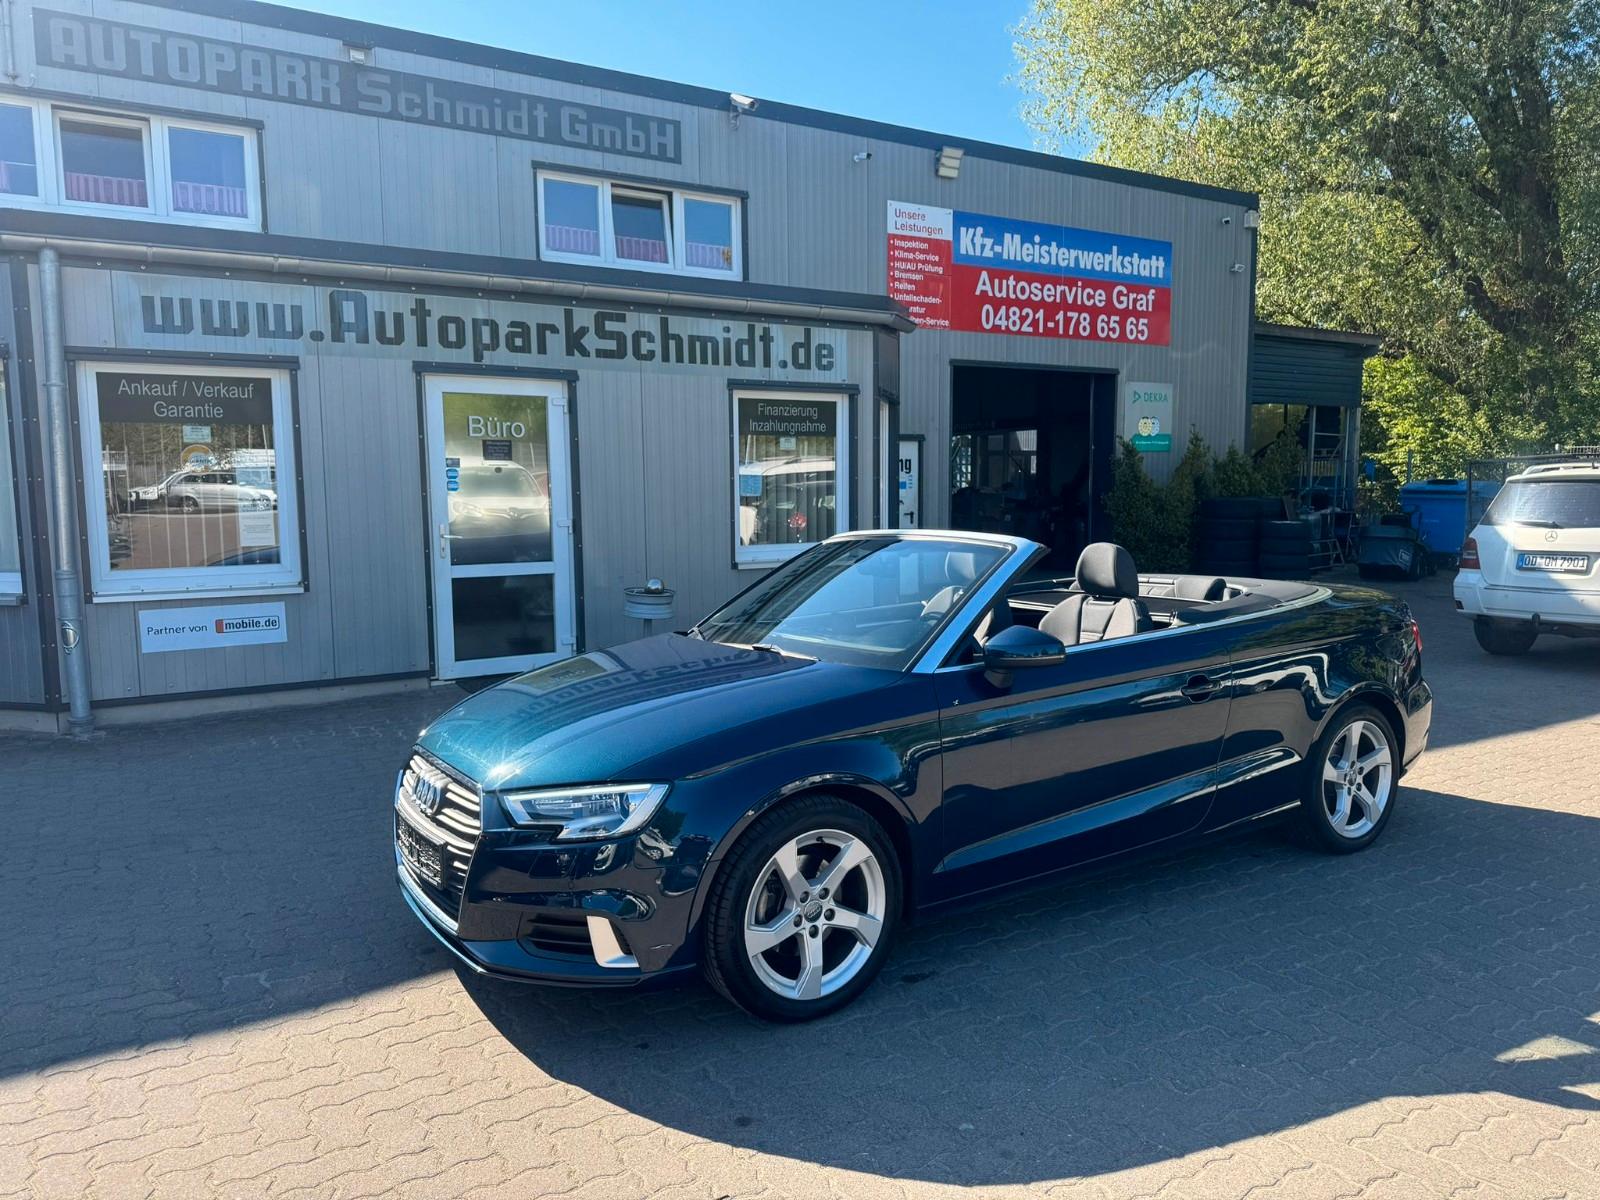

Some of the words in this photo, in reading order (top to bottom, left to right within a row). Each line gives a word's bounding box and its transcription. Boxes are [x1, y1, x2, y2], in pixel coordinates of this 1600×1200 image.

[49, 17, 342, 105] AUTOPARK
[356, 71, 549, 138] Schmidt
[560, 105, 676, 159] GmbH
[894, 207, 926, 221] Unsere
[894, 219, 944, 236] Leistungen
[894, 238, 929, 250] Inspektion
[894, 249, 940, 262] Klima-Service
[959, 226, 1166, 279] Kfz-Meisterwerkstatt
[894, 261, 917, 271] HU/AU
[917, 263, 944, 275] Prüfung
[894, 270, 924, 281] Bremsen
[894, 281, 916, 291] Reifen
[975, 270, 1107, 308] Autoservice
[1112, 285, 1157, 313] Graf
[141, 289, 834, 372] www.AutoparkSchmidt.de
[981, 304, 1091, 337] 04821-178
[1096, 313, 1121, 338] 65
[1126, 316, 1149, 341] 65
[118, 378, 178, 397] Ankauf
[192, 381, 255, 399] Verkauf
[1144, 392, 1168, 403] DEKRA
[153, 401, 224, 418] Garantie
[758, 403, 818, 419] Finanzierung
[467, 415, 526, 438] Büro
[749, 419, 827, 434] Inzahlungnahme
[1560, 557, 1585, 568] 7901
[146, 626, 186, 636] Partner
[188, 624, 208, 632] von
[224, 616, 278, 631] mobile.de
